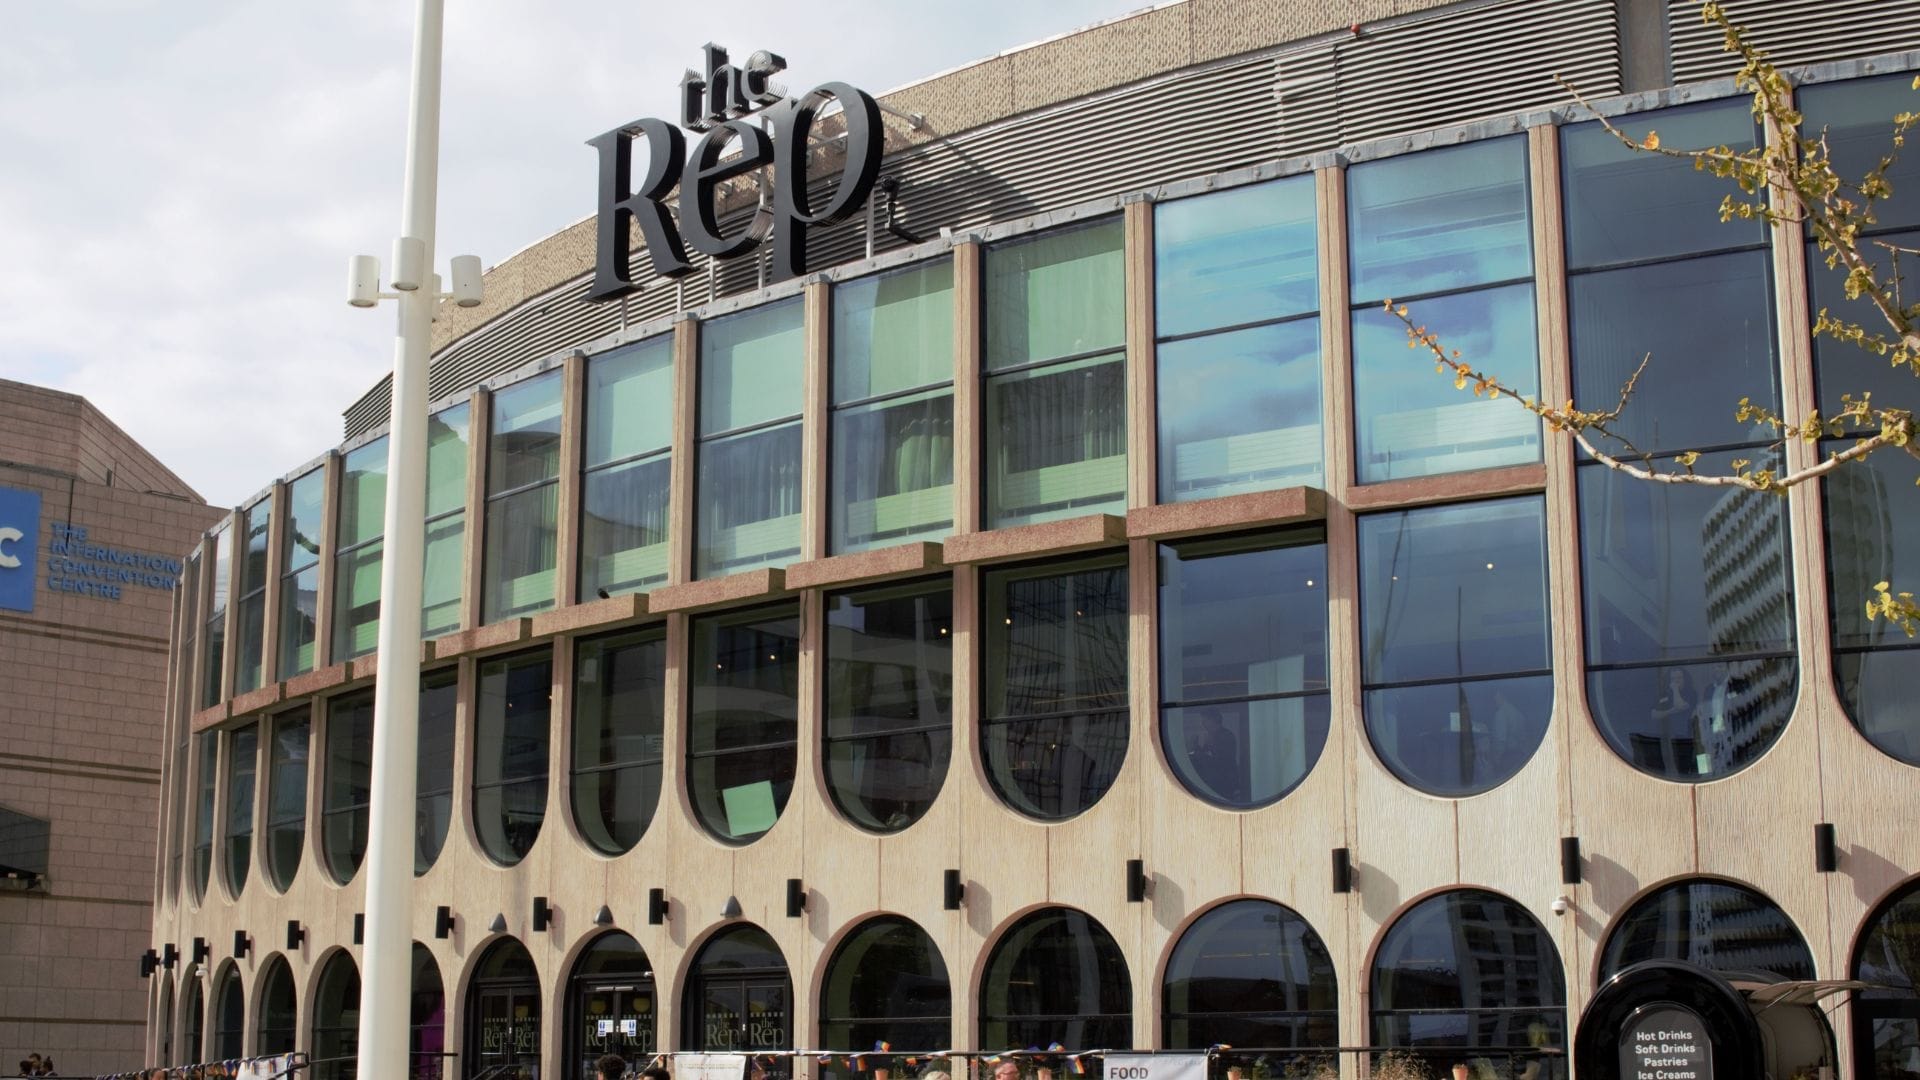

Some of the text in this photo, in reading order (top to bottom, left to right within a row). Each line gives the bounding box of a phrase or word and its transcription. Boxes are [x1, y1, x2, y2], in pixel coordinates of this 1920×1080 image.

[681, 41, 787, 134] the
[584, 81, 884, 304] Rep
[51, 521, 88, 541] THE
[0, 527, 24, 569] C
[50, 541, 184, 576] INTERNATION
[48, 555, 175, 591] CONVENTION
[48, 575, 122, 600] CENTRE
[705, 1023, 740, 1051] Rep
[750, 1022, 784, 1051] Rep
[1635, 1043, 1696, 1054] Soft Drinks
[1636, 1030, 1693, 1041] Hot Drinks
[1110, 1067, 1149, 1080] FOOD
[1644, 1056, 1688, 1067] Pastries
[1637, 1070, 1696, 1080] Ice Creams
